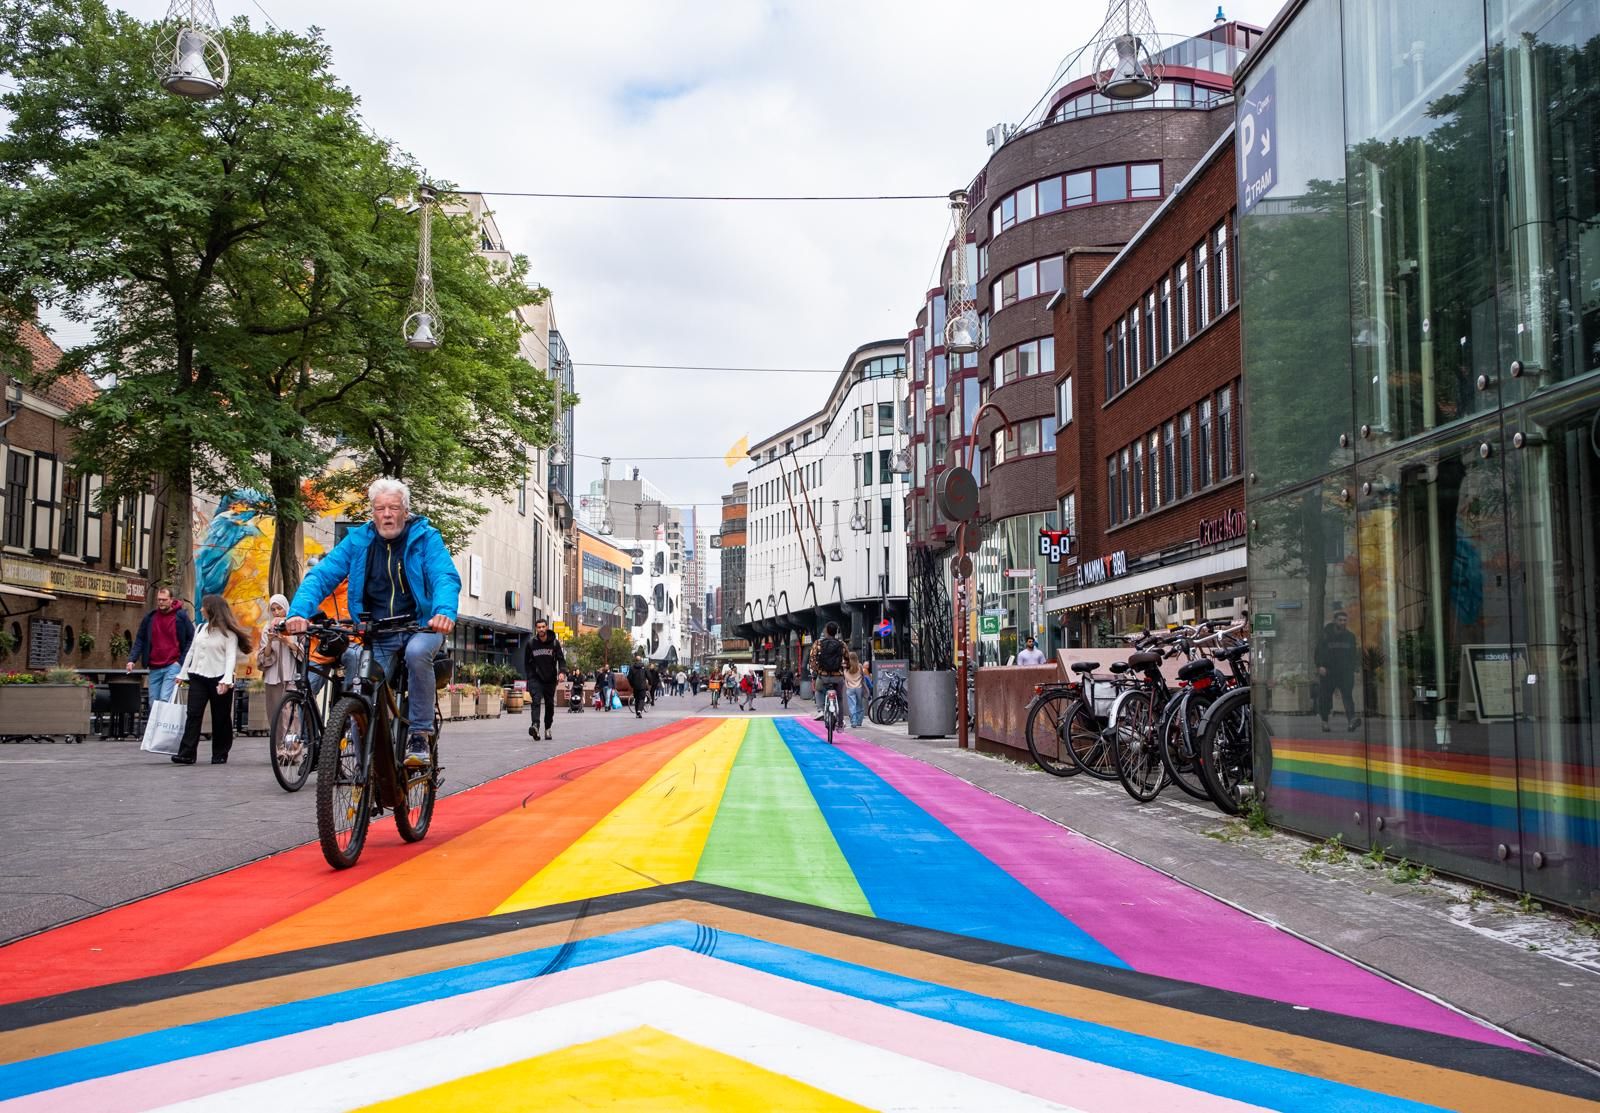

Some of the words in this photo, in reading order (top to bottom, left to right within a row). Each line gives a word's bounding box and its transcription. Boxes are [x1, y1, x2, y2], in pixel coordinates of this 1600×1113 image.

[1241, 113, 1254, 182] P
[1251, 168, 1272, 201] TRAM
[50, 570, 65, 586] ROOTZ
[74, 574, 88, 589] GREAT
[88, 577, 102, 591] CRAFT
[102, 579, 111, 592] BEER
[1077, 565, 1084, 586] EL
[1084, 557, 1105, 584] MAMMA
[1112, 550, 1126, 575] BBQ
